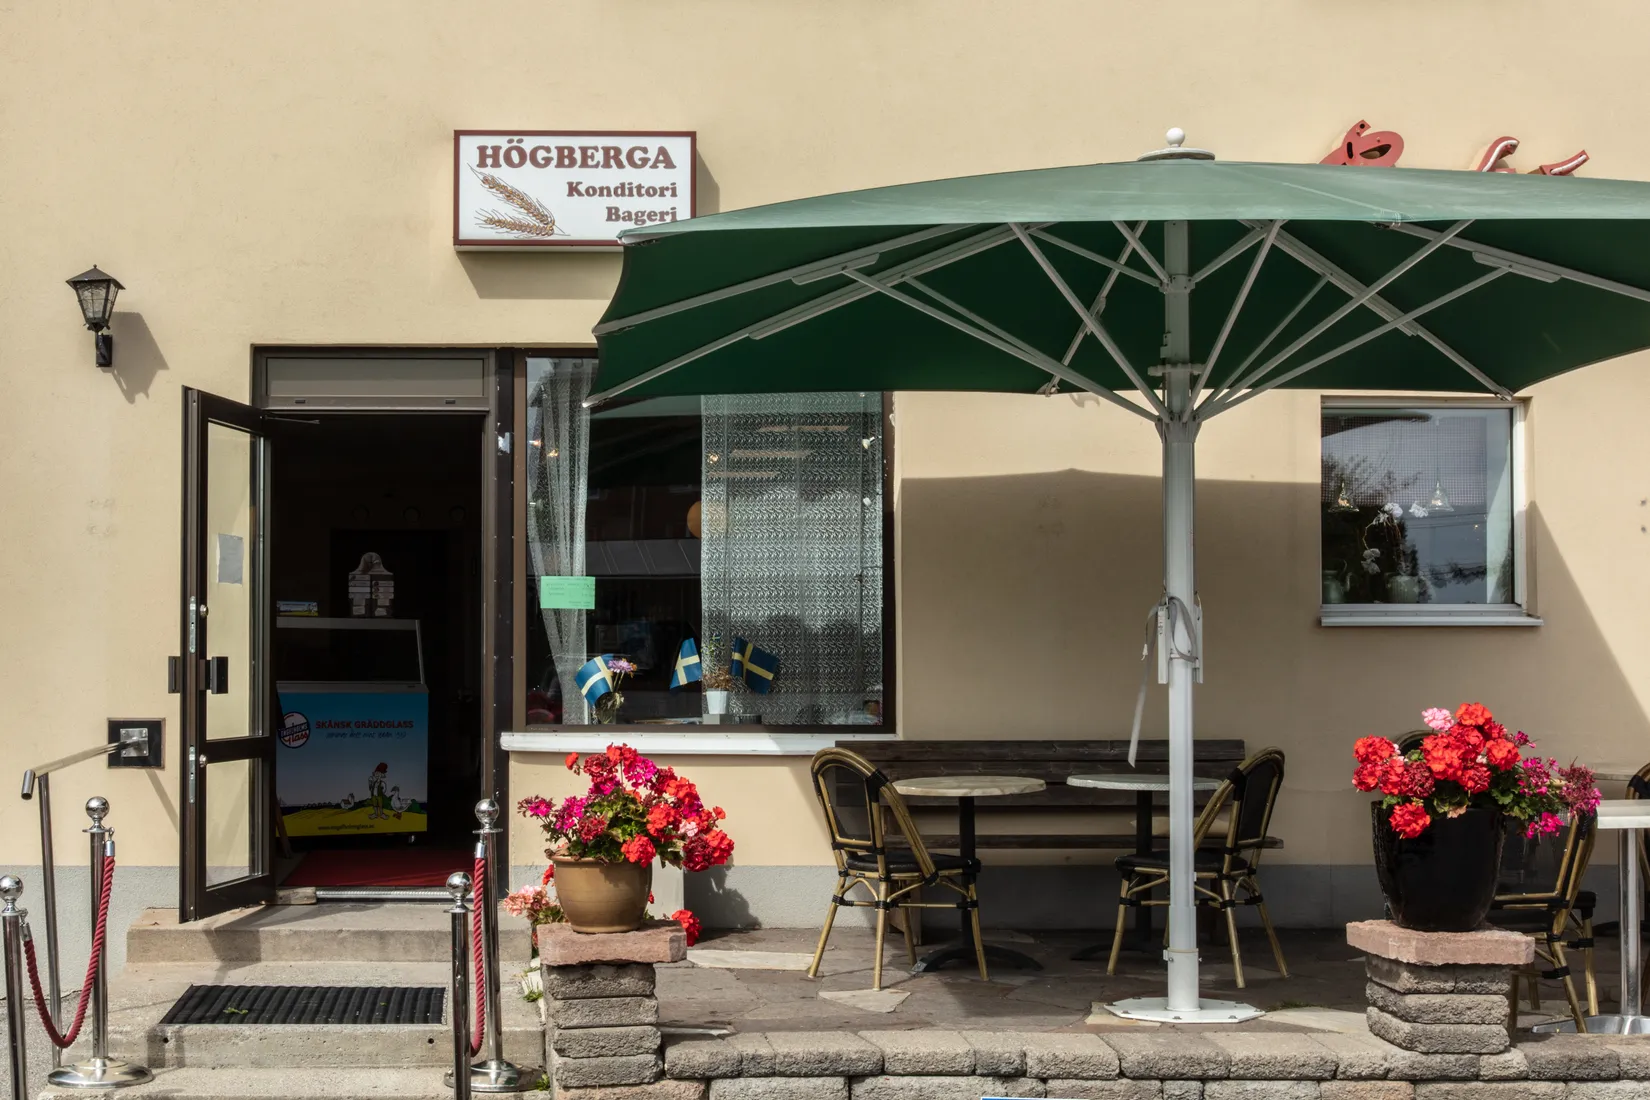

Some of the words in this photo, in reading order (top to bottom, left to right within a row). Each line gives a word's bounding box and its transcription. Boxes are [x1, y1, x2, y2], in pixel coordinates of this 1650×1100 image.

[476, 138, 676, 169] HÖGBERGA
[567, 181, 677, 198] Konditori
[606, 206, 677, 226] Bageri
[315, 719, 352, 729] SKÅNSK
[354, 719, 414, 729] GRÄDDGLASS
